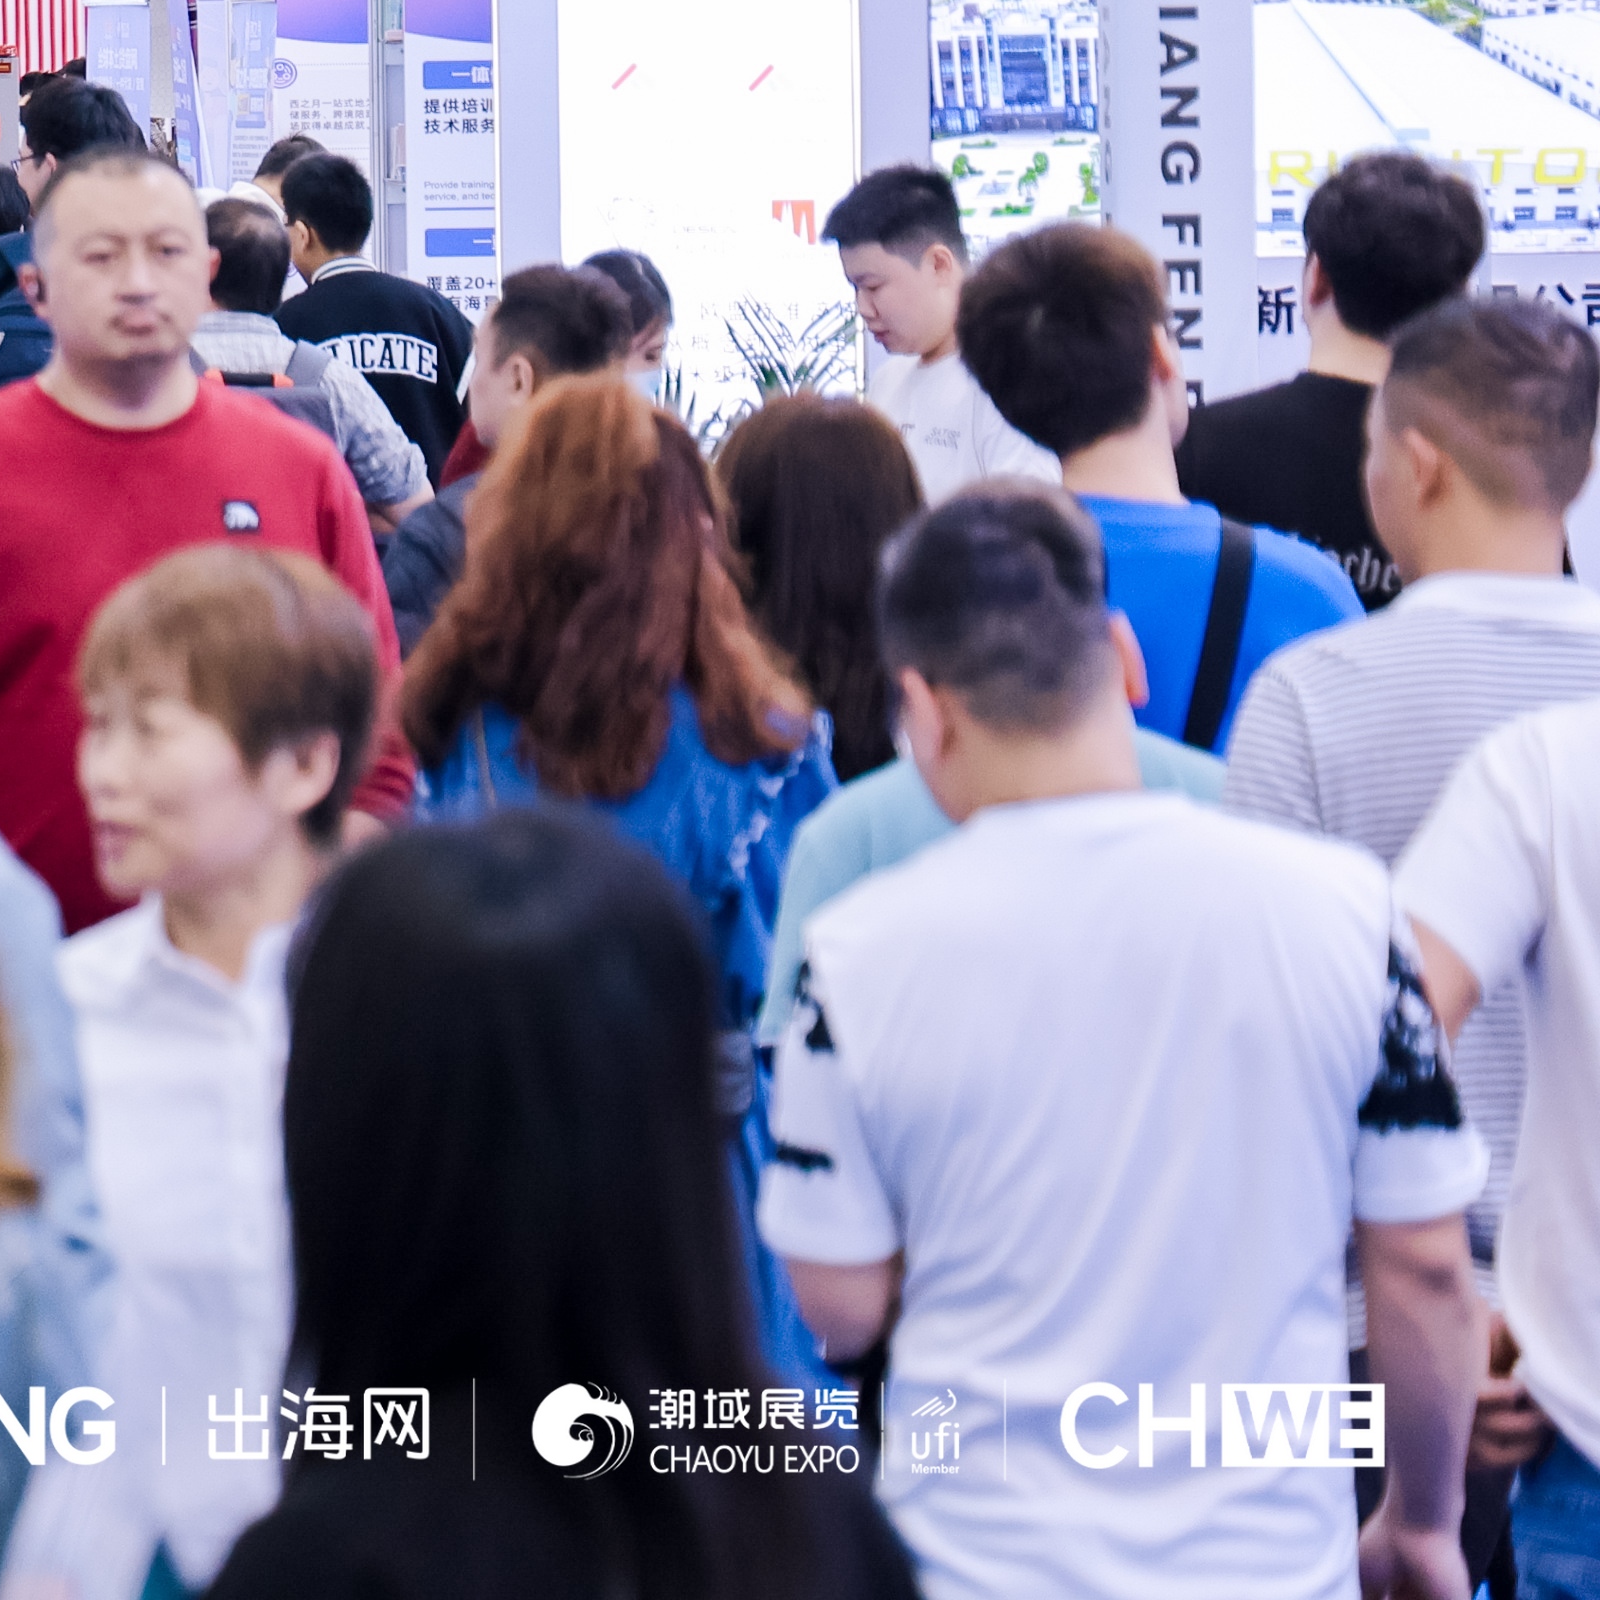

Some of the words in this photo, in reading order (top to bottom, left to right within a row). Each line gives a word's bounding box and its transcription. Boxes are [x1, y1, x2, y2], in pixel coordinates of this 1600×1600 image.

[452, 66, 493, 84] 一体
[424, 181, 458, 190] Provide
[424, 192, 459, 201] service,
[462, 192, 480, 201] and
[482, 192, 495, 201] tec
